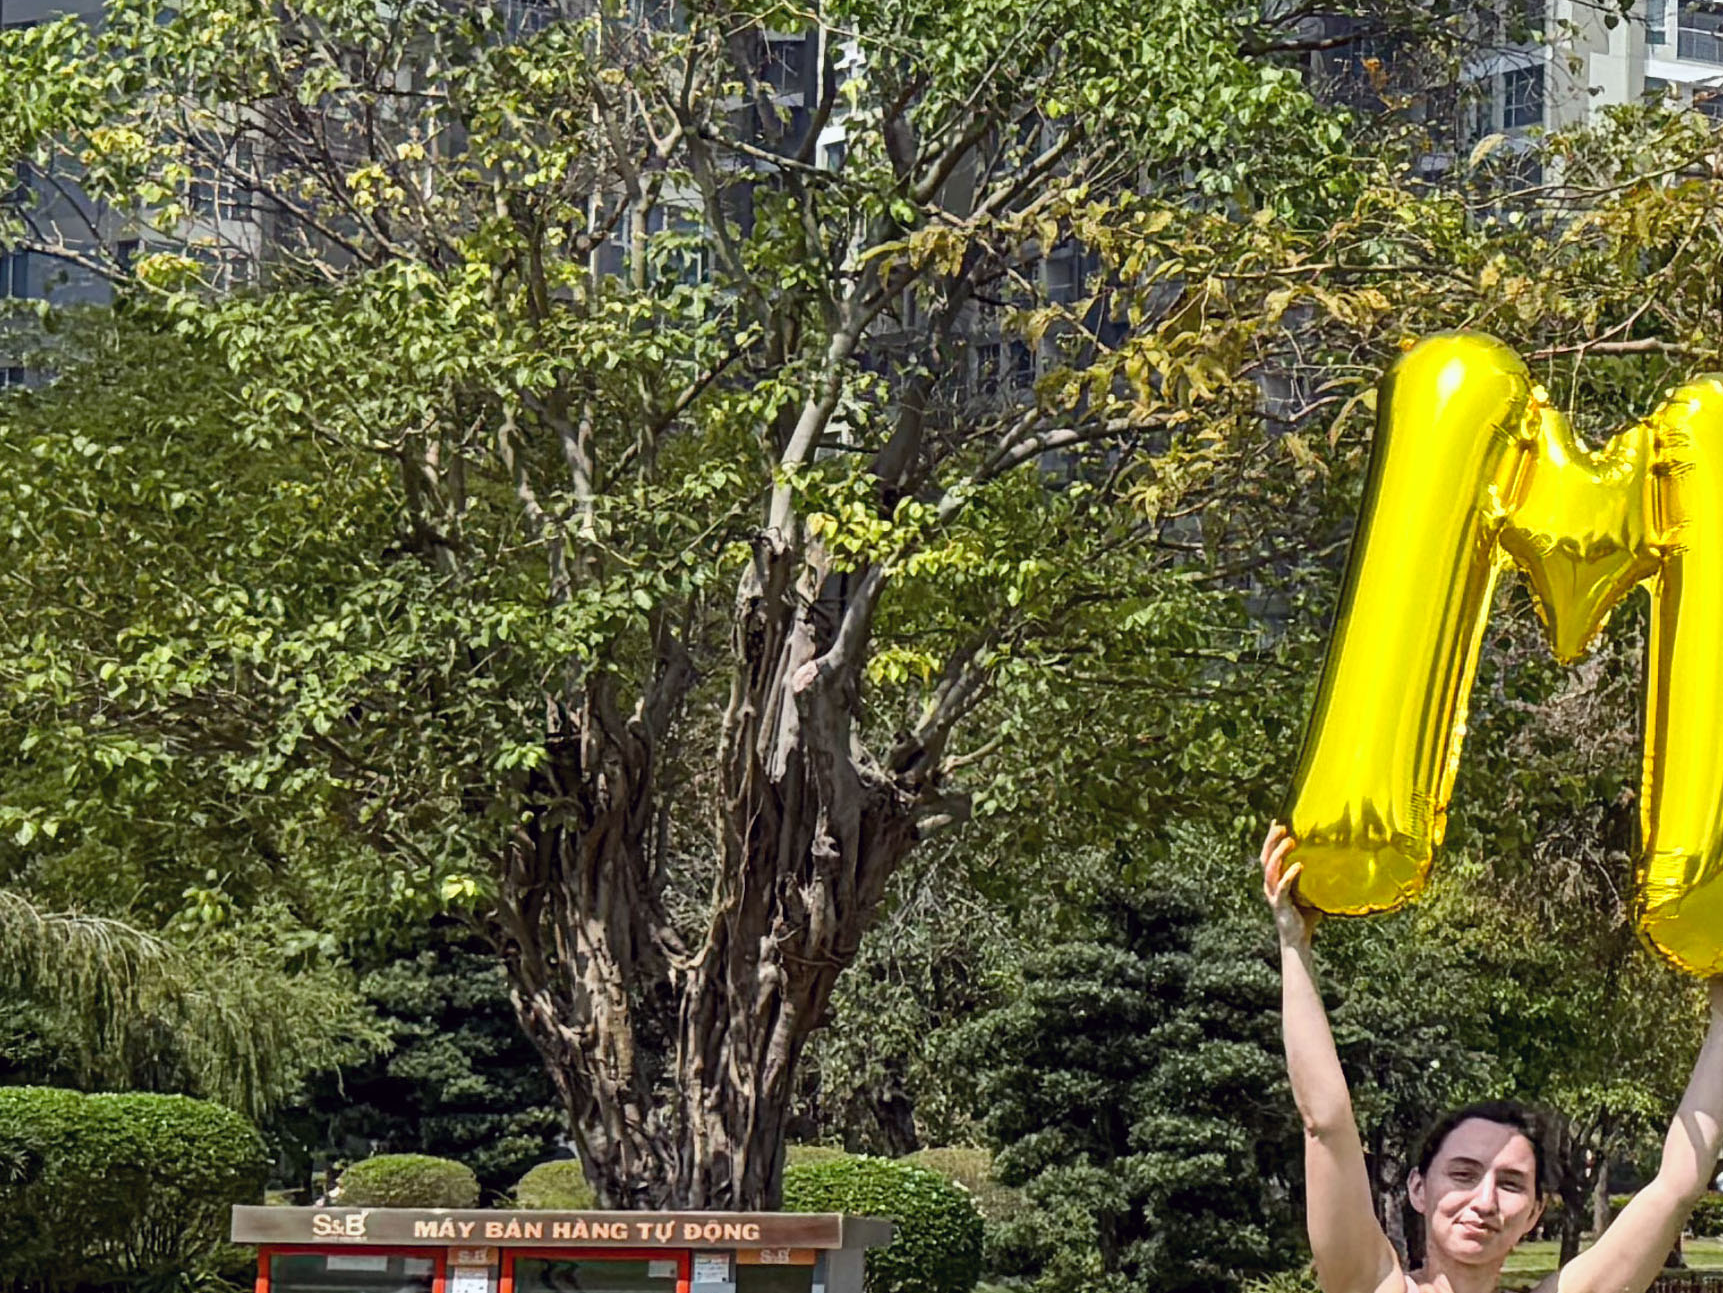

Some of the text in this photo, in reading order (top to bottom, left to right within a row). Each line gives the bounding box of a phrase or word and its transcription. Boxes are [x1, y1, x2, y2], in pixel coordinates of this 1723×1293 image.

[312, 1210, 369, 1237] S&B
[414, 1216, 761, 1244] MÁY BÁN HÀNG TỰ ĐỘNG
